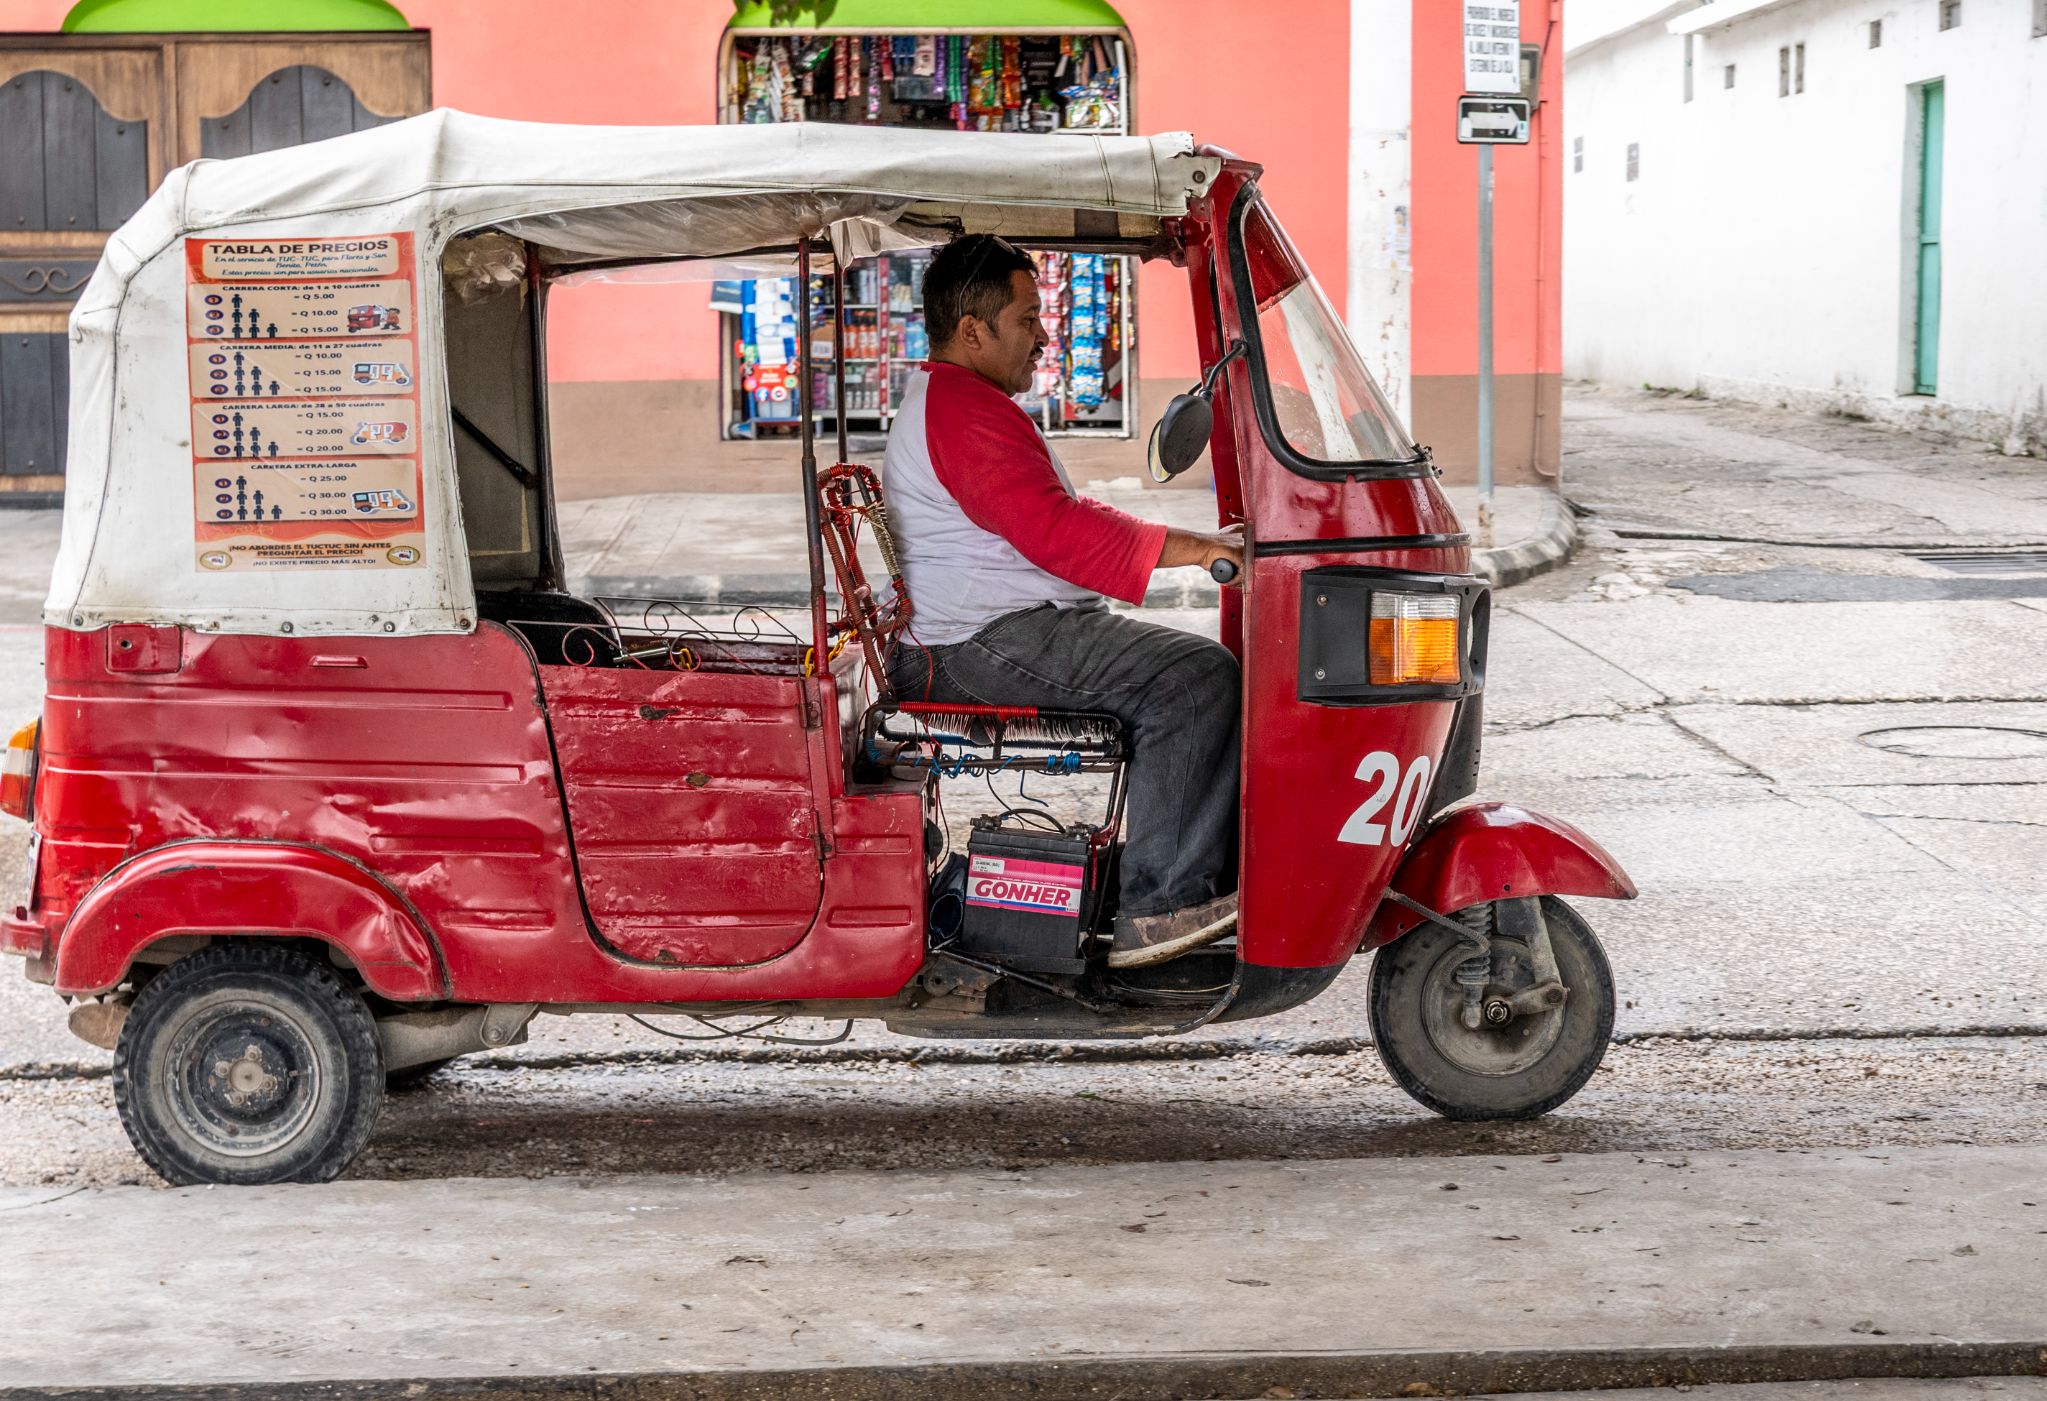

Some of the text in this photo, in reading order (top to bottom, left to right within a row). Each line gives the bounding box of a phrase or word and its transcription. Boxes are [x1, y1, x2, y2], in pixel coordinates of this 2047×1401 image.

[209, 240, 388, 254] TABLA DE PRECIOS
[303, 293, 311, 301] Q
[300, 310, 308, 318] Q
[309, 475, 317, 483] Q
[308, 492, 317, 500] Q
[309, 509, 317, 517] Q
[1337, 750, 1431, 848] 20
[975, 880, 1071, 906] GONHER
